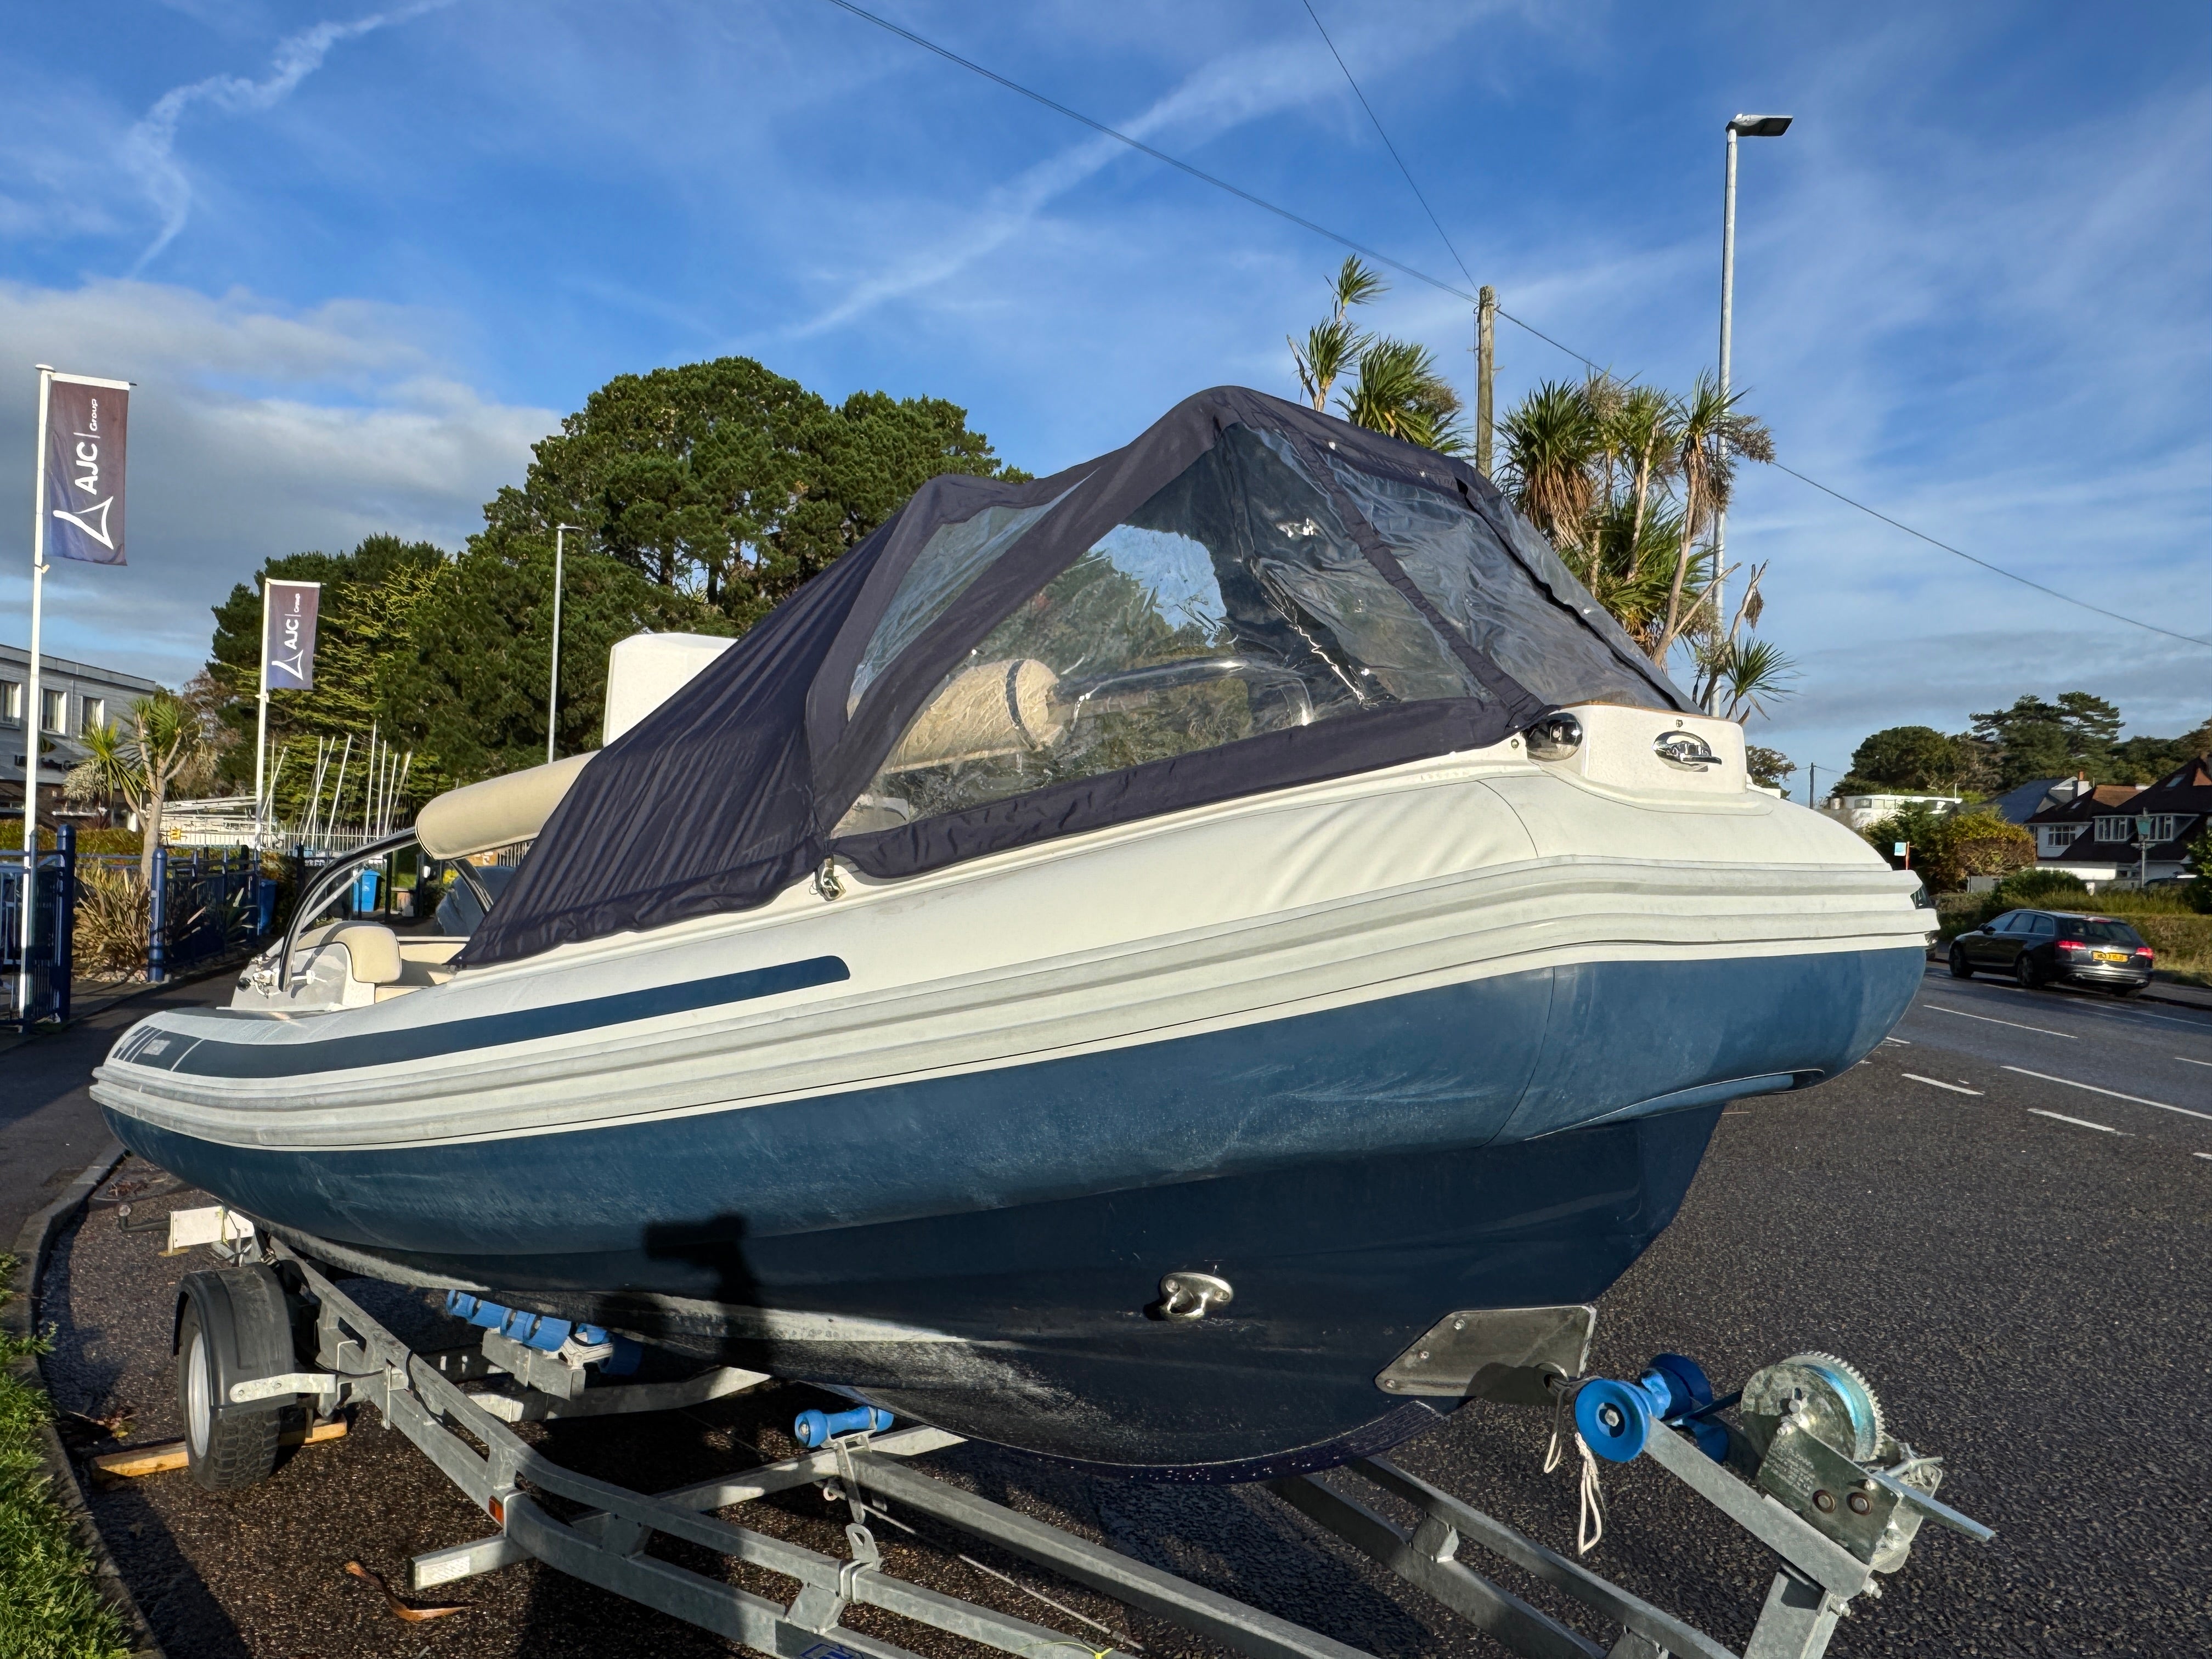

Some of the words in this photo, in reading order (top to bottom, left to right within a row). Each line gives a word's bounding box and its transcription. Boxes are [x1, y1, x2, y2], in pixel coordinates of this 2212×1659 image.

[75, 441, 99, 495] AJC
[89, 398, 99, 432] Group
[284, 618, 299, 650] AJC
